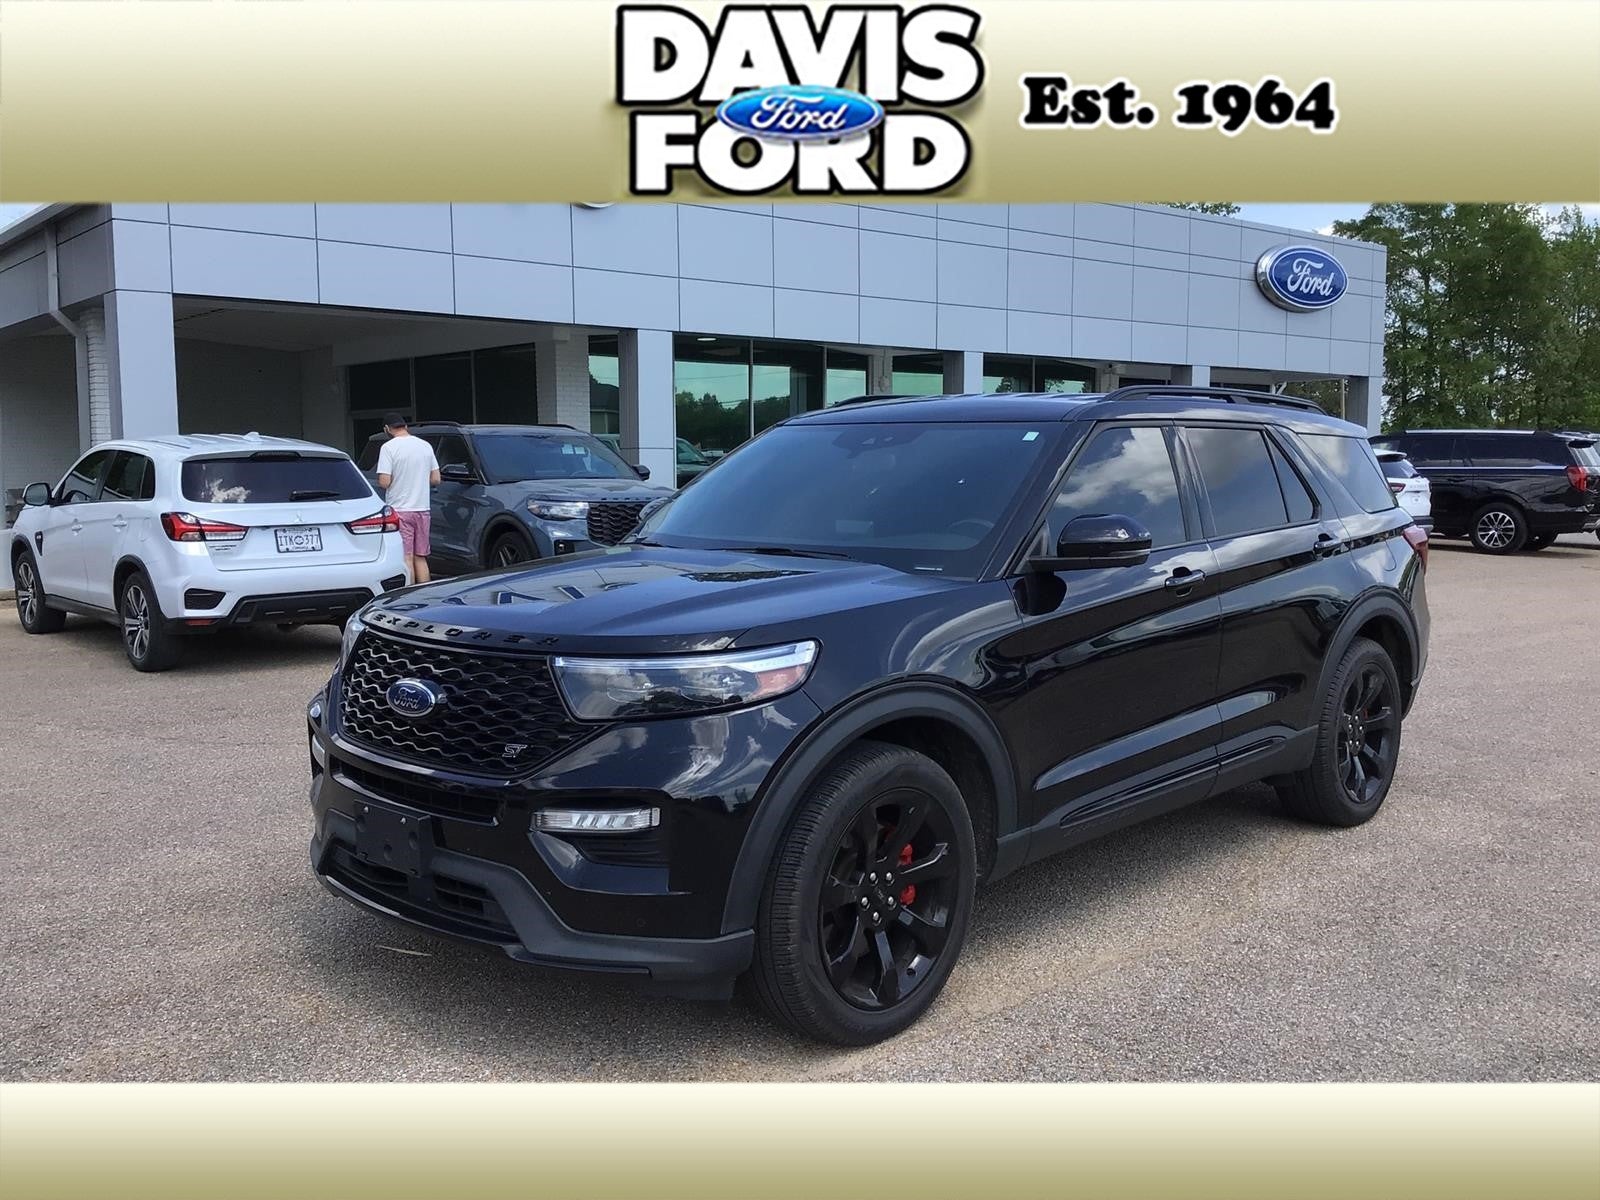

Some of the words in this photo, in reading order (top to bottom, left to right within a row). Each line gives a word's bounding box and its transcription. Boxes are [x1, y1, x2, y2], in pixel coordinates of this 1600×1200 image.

[1287, 258, 1335, 297] Ford
[372, 613, 560, 647] EXPLORER
[393, 686, 422, 710] Ford
